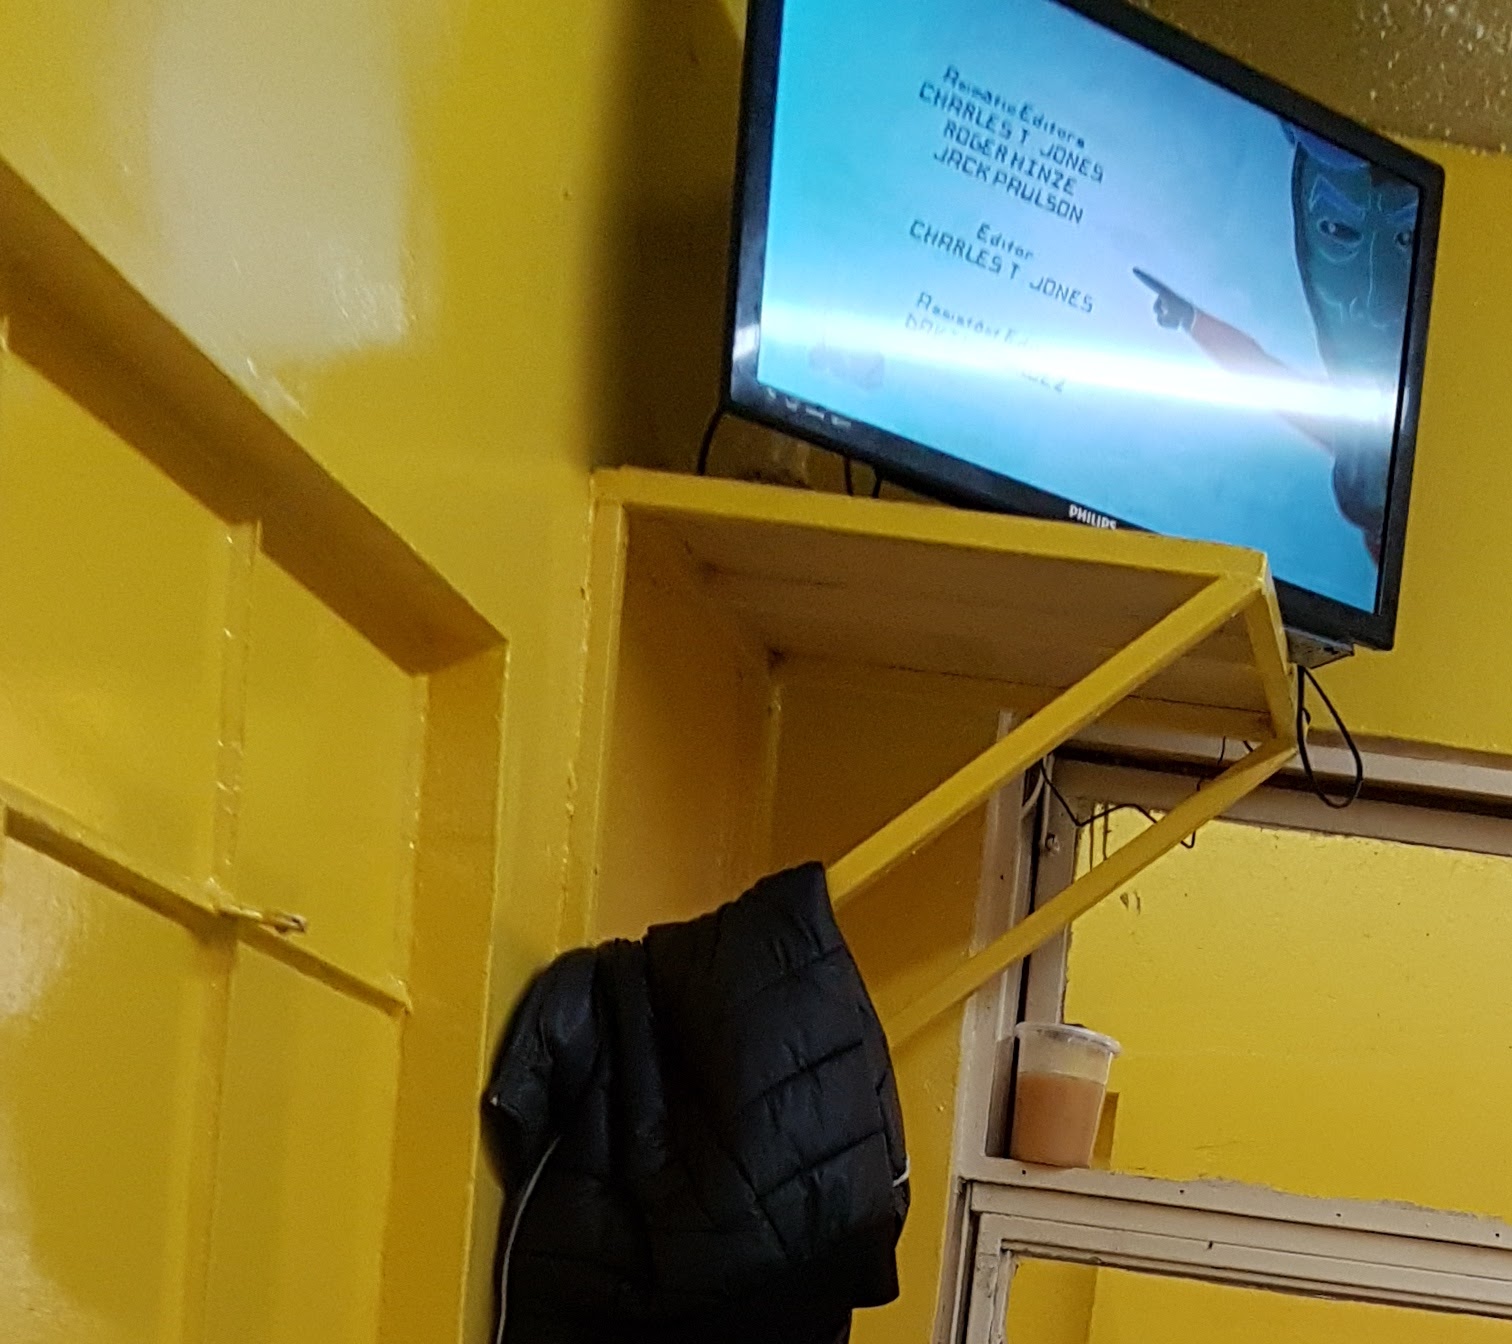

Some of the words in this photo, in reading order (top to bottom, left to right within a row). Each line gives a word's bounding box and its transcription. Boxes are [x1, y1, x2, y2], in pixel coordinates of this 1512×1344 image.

[918, 81, 1012, 141] CHARLES
[1020, 127, 1031, 145] T
[1039, 143, 1104, 184] JONES
[942, 119, 1009, 164] ROGER
[1009, 151, 1077, 196] HINZE
[1019, 102, 1086, 149] Editors
[933, 146, 991, 183] JACK
[992, 170, 1085, 224] PAULSON
[908, 219, 1002, 274] CHARLES
[1009, 262, 1020, 280] T
[1029, 276, 1093, 314] JONES
[976, 222, 1034, 260] Editor
[1068, 503, 1117, 531] PHILIPS
